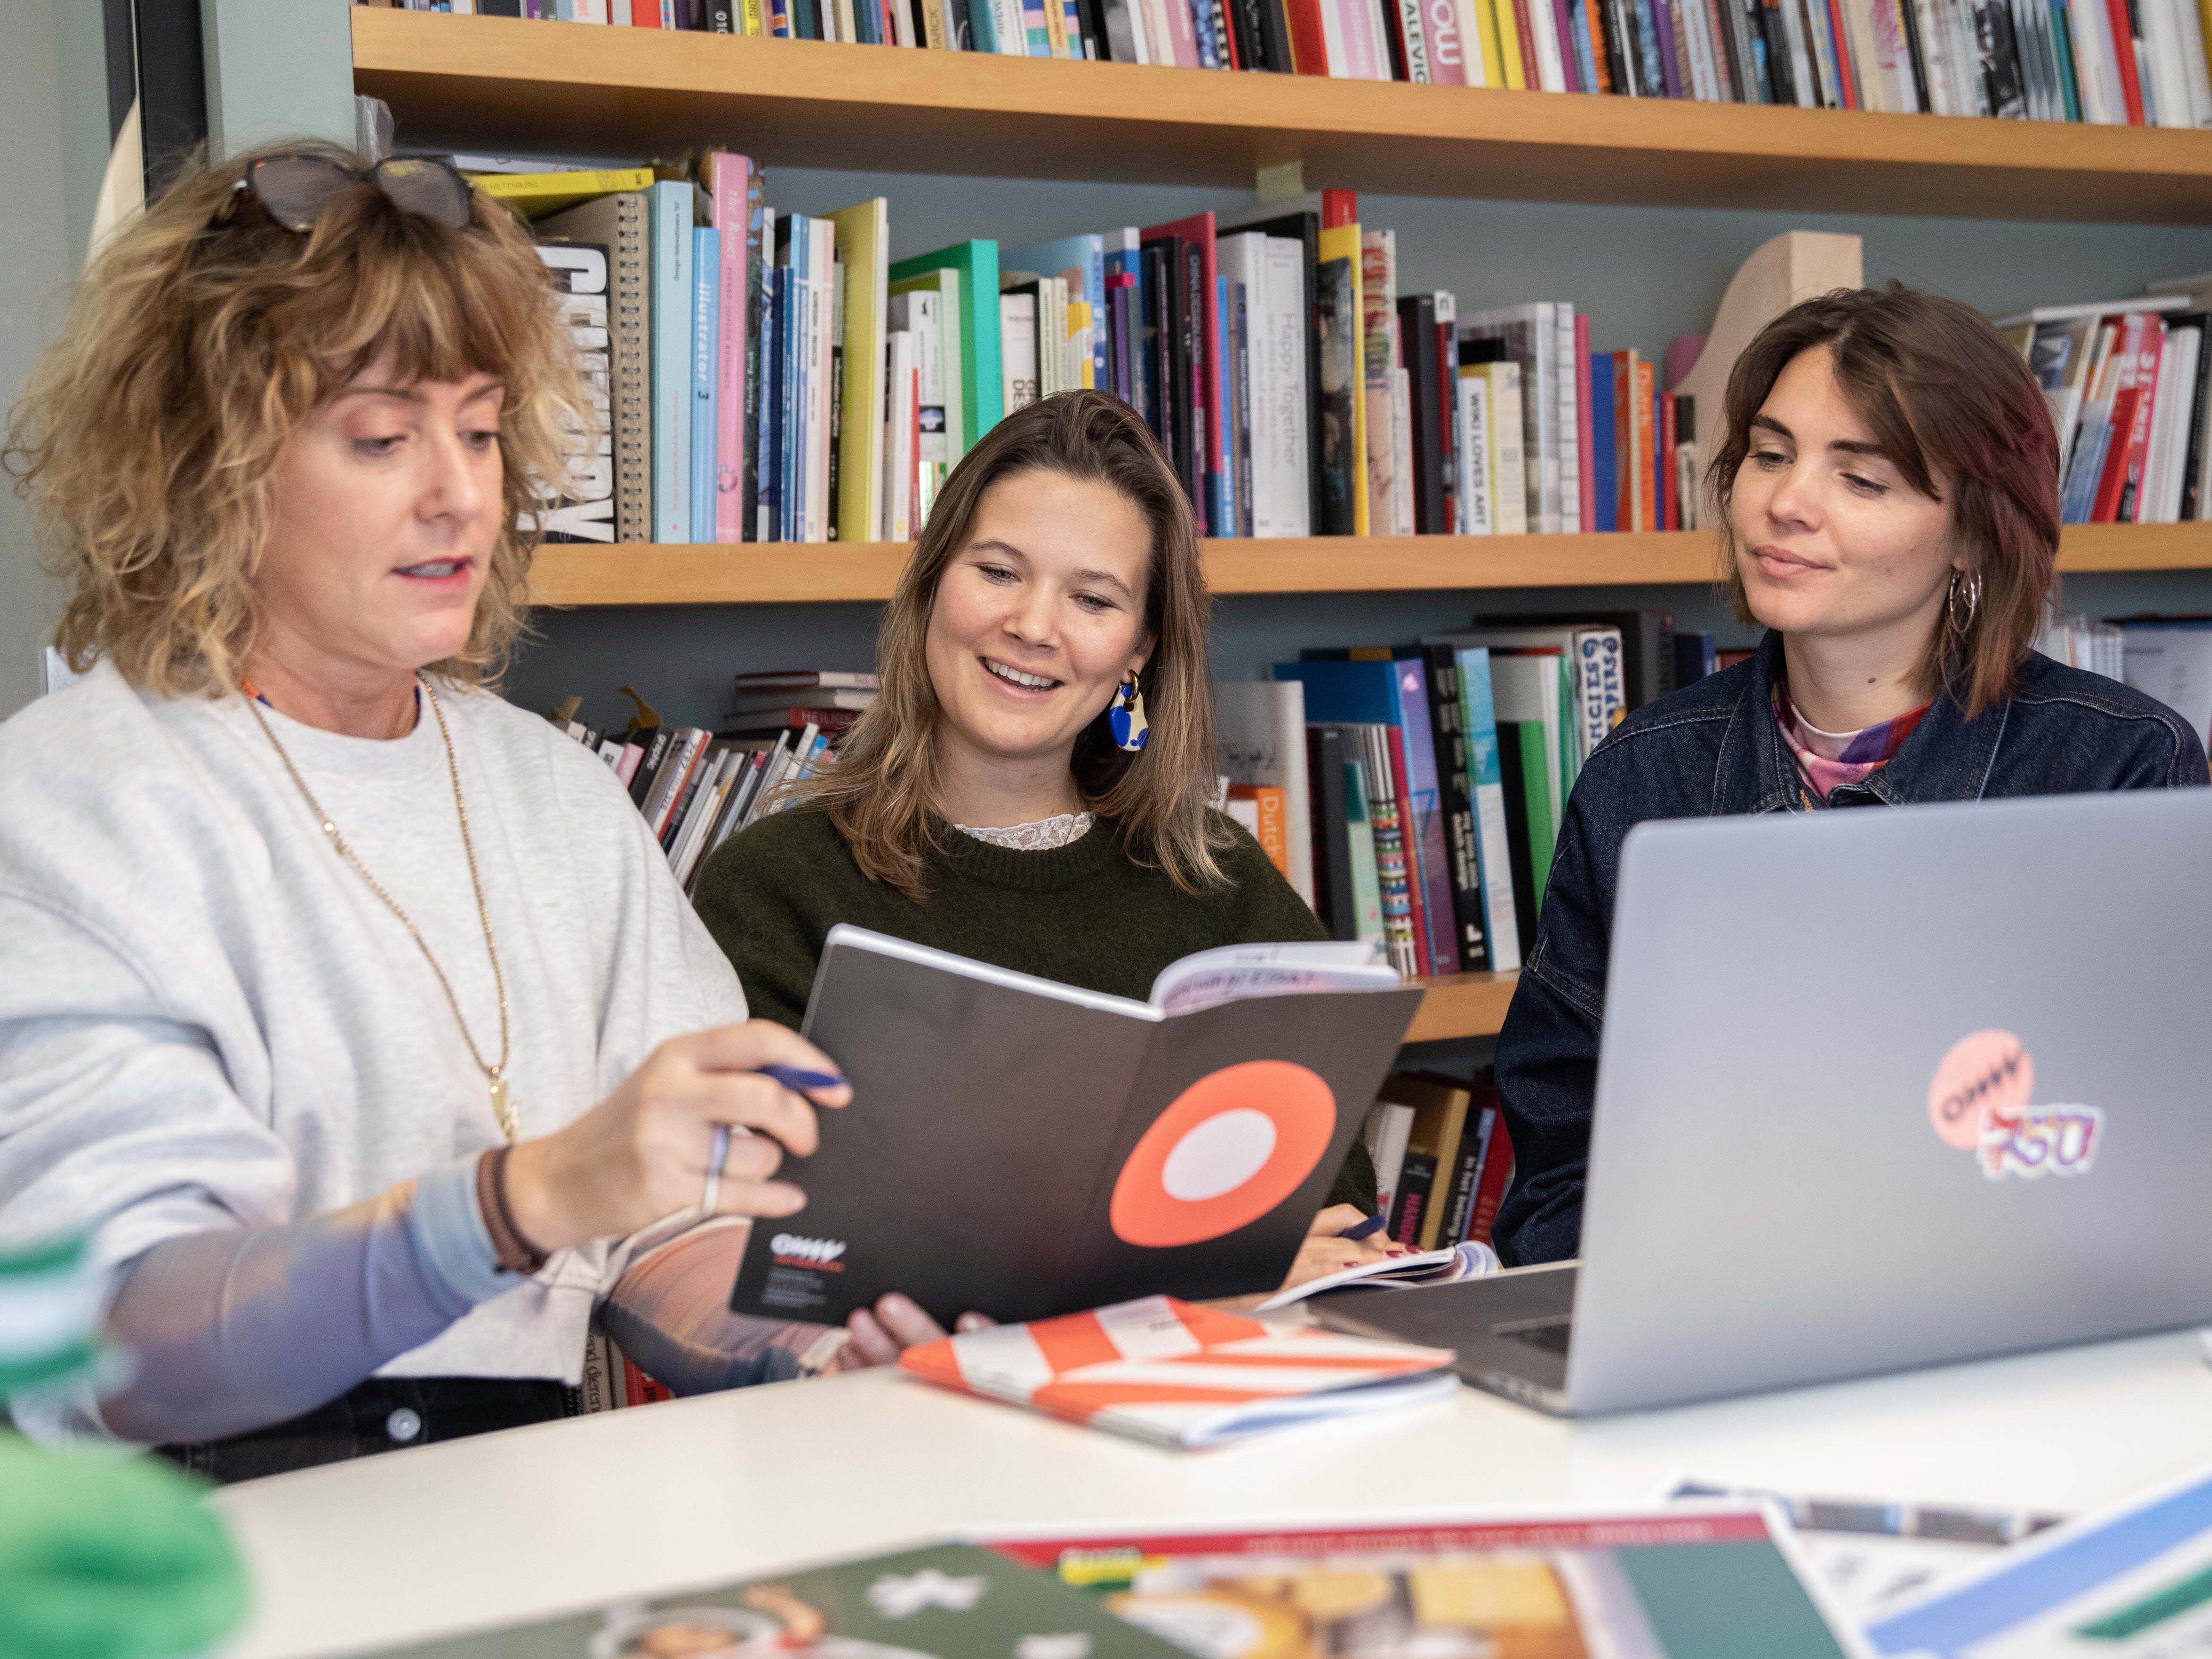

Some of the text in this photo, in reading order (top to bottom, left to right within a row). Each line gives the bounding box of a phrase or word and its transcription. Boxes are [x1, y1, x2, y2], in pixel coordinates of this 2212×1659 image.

[697, 282, 711, 401] illustrator 3
[1279, 312, 1299, 467] Happy Together
[1473, 435, 1484, 487] LOVES
[1476, 494, 1486, 526] ART
[647, 734, 666, 769] graphic
[1262, 796, 1281, 857] Dutch
